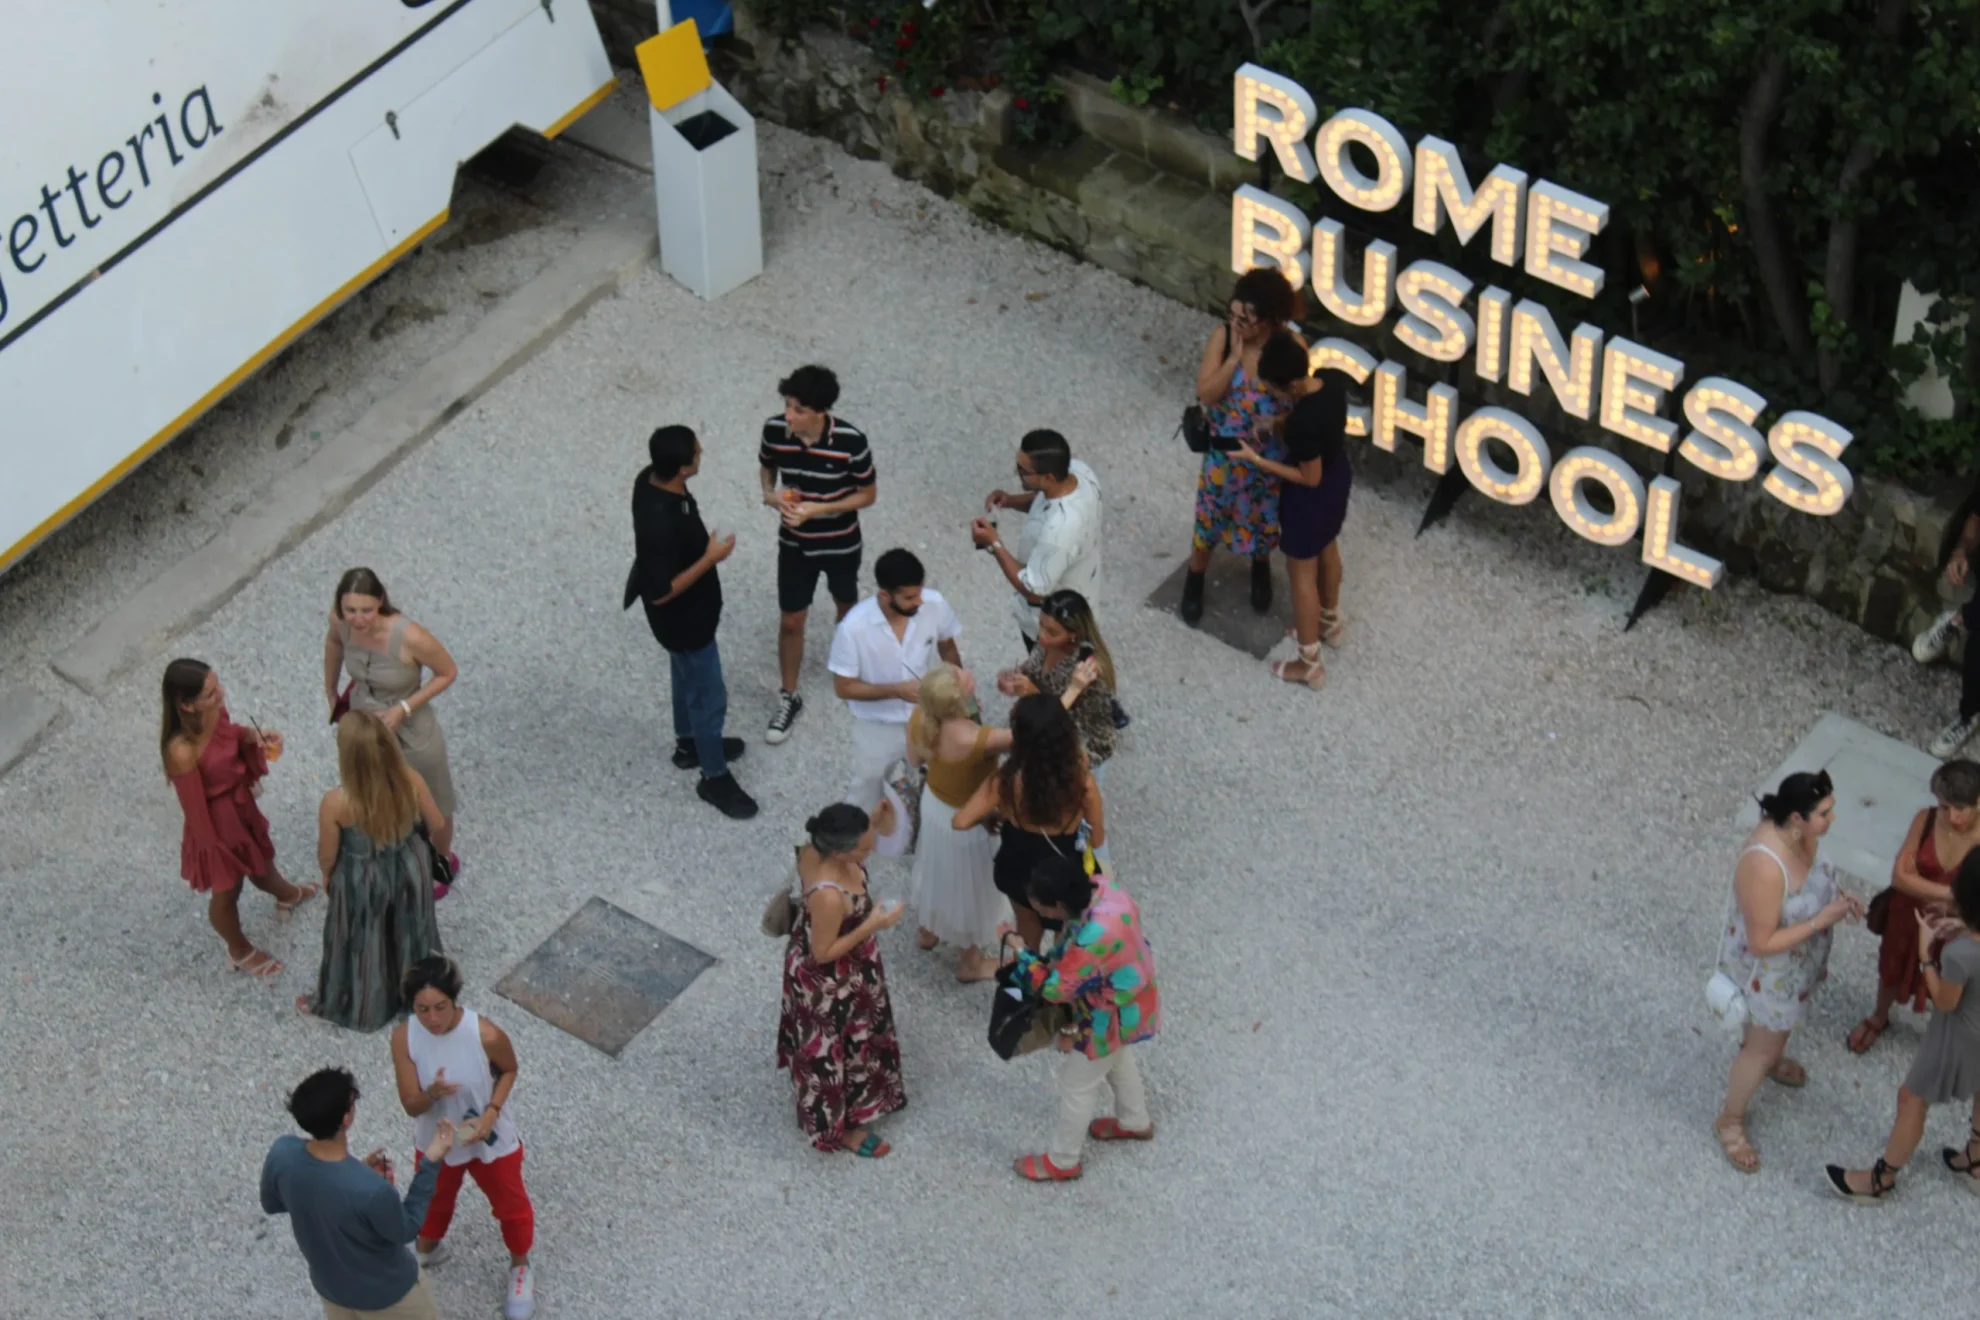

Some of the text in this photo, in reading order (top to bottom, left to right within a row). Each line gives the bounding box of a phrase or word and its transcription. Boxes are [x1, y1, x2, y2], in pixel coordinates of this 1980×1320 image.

[0, 84, 224, 324] etteria
[1233, 62, 1609, 299] ROME
[1231, 183, 1853, 516] BUSINESS
[1288, 320, 1724, 590] CHOOL
